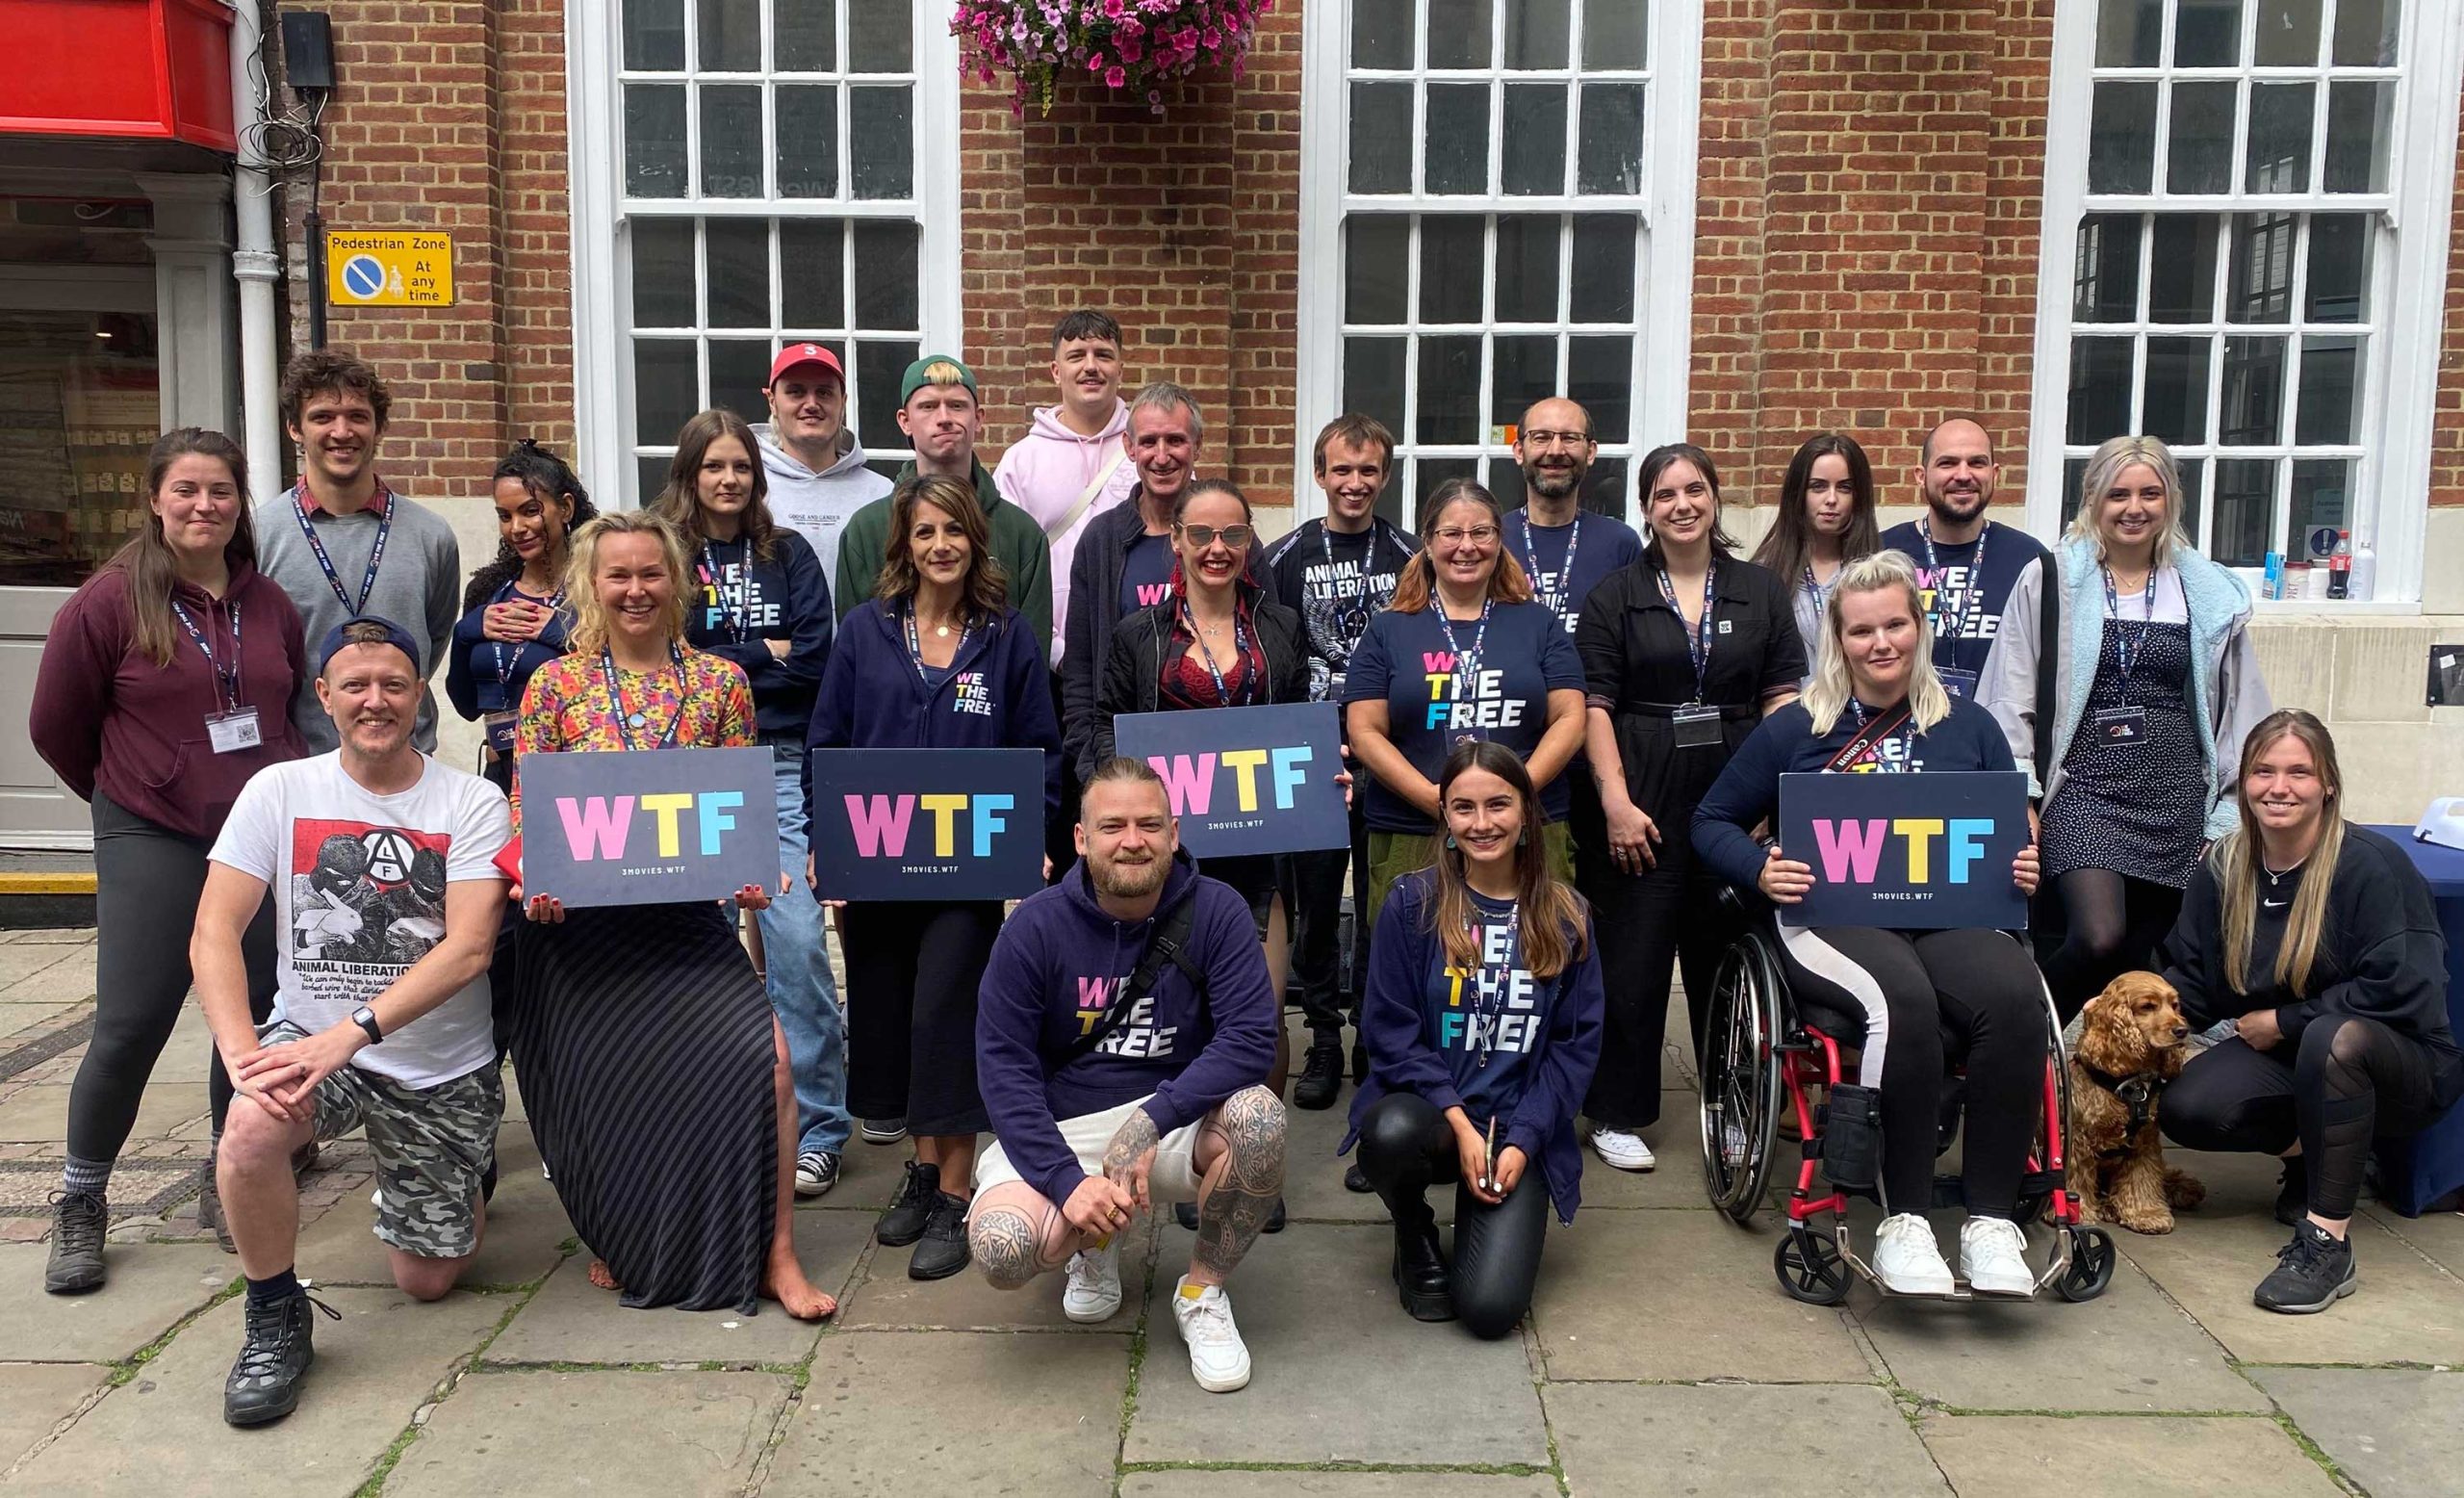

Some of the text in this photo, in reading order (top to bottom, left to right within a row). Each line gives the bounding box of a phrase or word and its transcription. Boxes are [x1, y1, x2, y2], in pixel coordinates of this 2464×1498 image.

[332, 237, 446, 249] Pedestrian Zone
[415, 261, 431, 271] At
[411, 277, 435, 289] any
[409, 290, 439, 300] time
[1305, 560, 1363, 582] ANIMAL
[706, 604, 781, 631] FREE
[957, 672, 984, 685] WE
[956, 684, 989, 700] THE
[953, 699, 991, 715] FREE
[1426, 700, 1527, 730] FREE
[1836, 738, 1868, 766] Canon
[1147, 746, 1313, 816] WTF
[555, 791, 744, 861] WTF
[844, 794, 1014, 857] WTF
[1208, 819, 1264, 830] 3MOVIES.WTF
[1812, 819, 1994, 884] WTF
[621, 866, 686, 876] 3MOVIES.WTF
[293, 961, 413, 976] ANIMAL LIBERATIO
[329, 974, 345, 984] only
[346, 975, 364, 988] begin
[1444, 967, 1535, 1009] THE
[353, 994, 369, 1002] that
